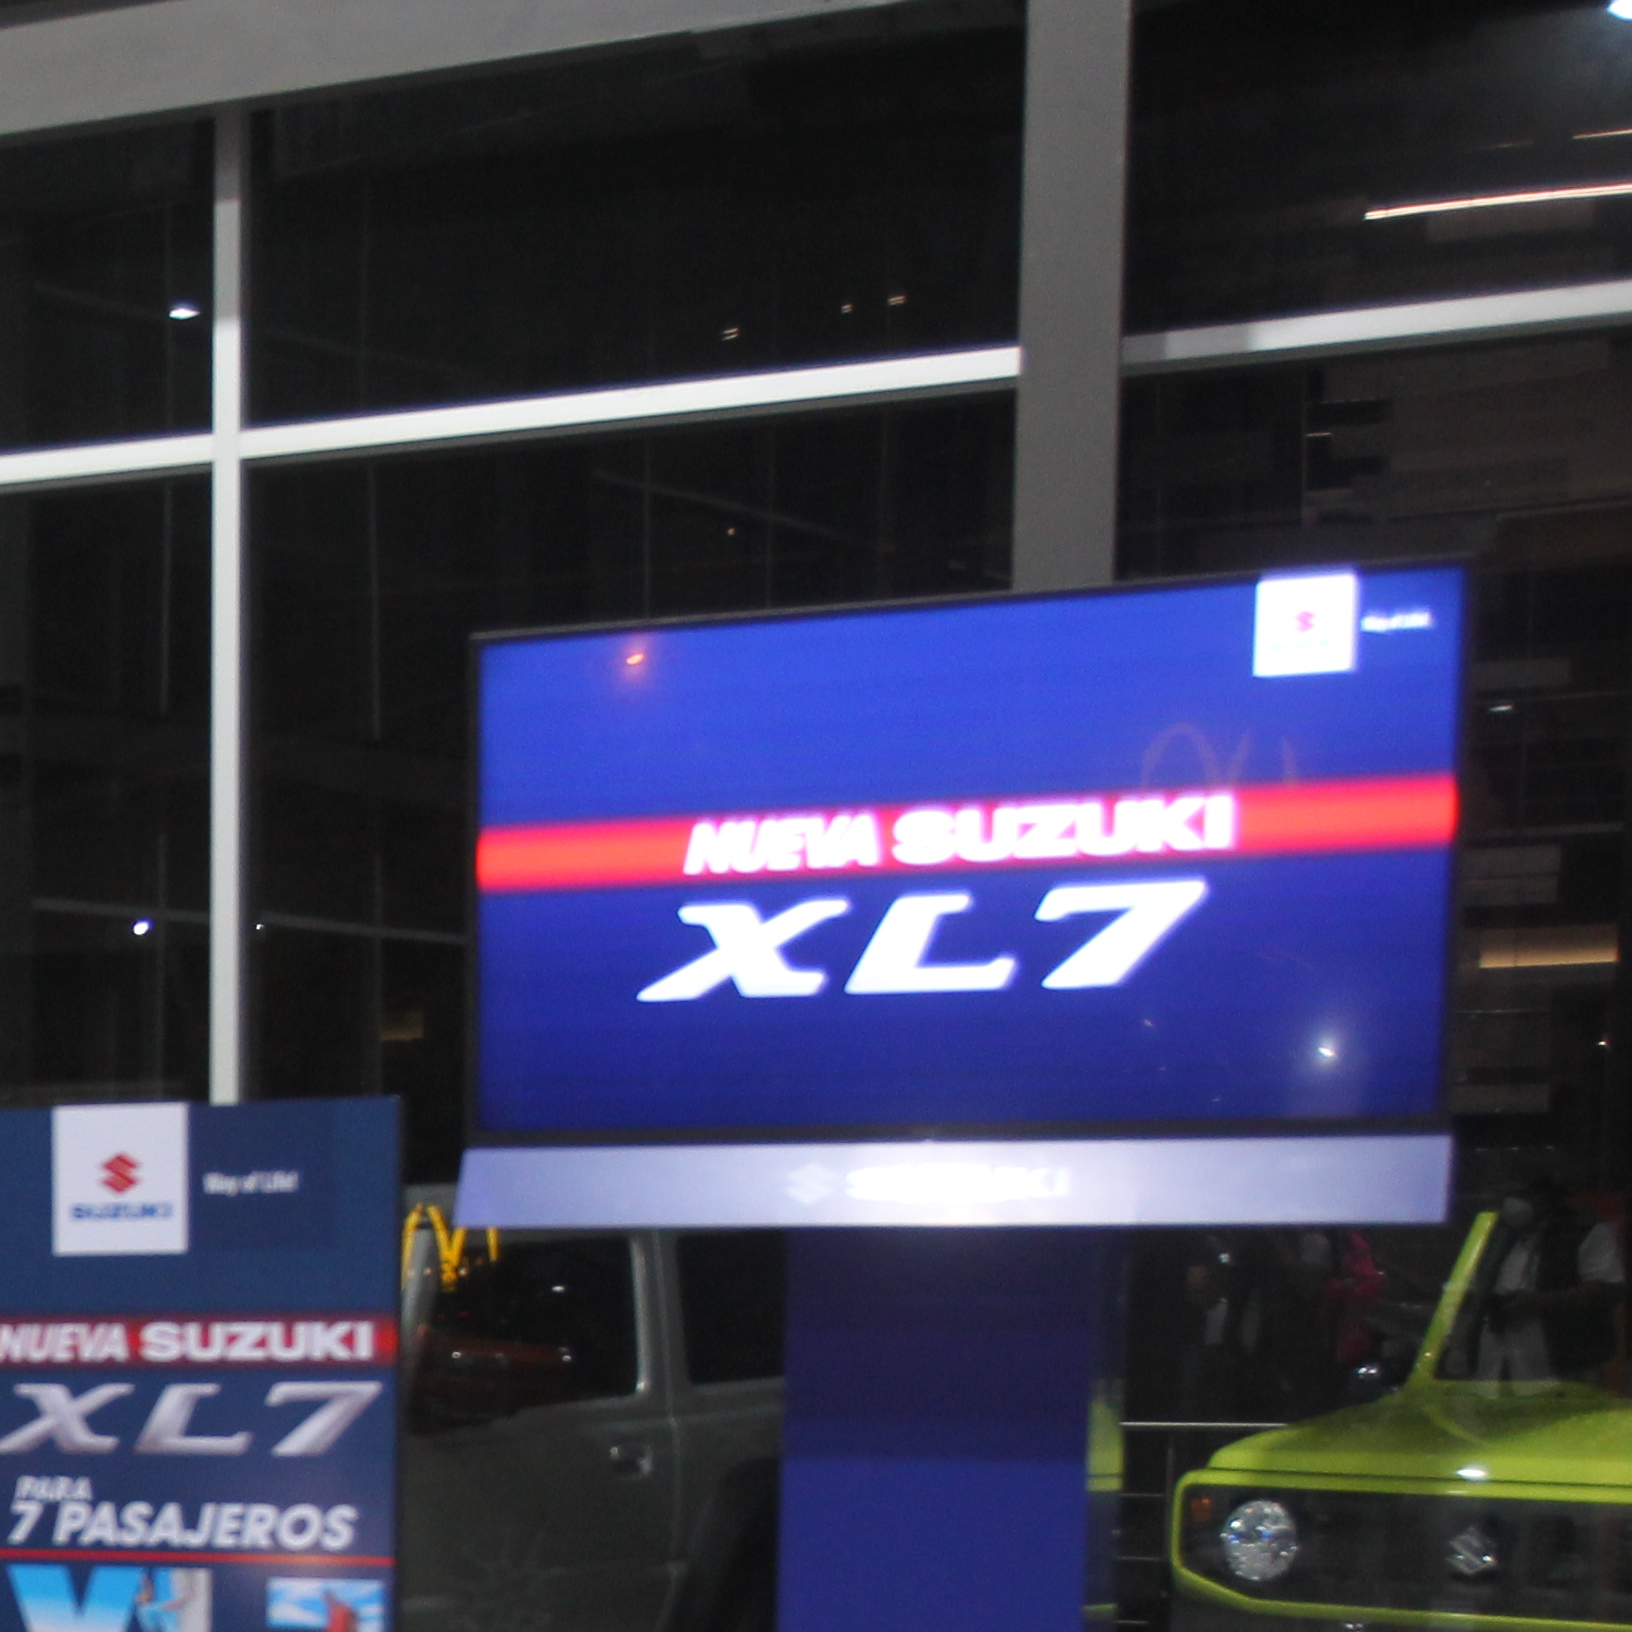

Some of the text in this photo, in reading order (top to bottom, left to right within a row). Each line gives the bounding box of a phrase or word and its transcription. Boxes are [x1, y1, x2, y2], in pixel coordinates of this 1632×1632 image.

[682, 793, 1238, 875] NUEVA SUZUKI
[637, 876, 1209, 1003] XL7
[138, 1320, 375, 1362] SUZUKI
[7, 1500, 359, 1550] 7 PASAJEROS
